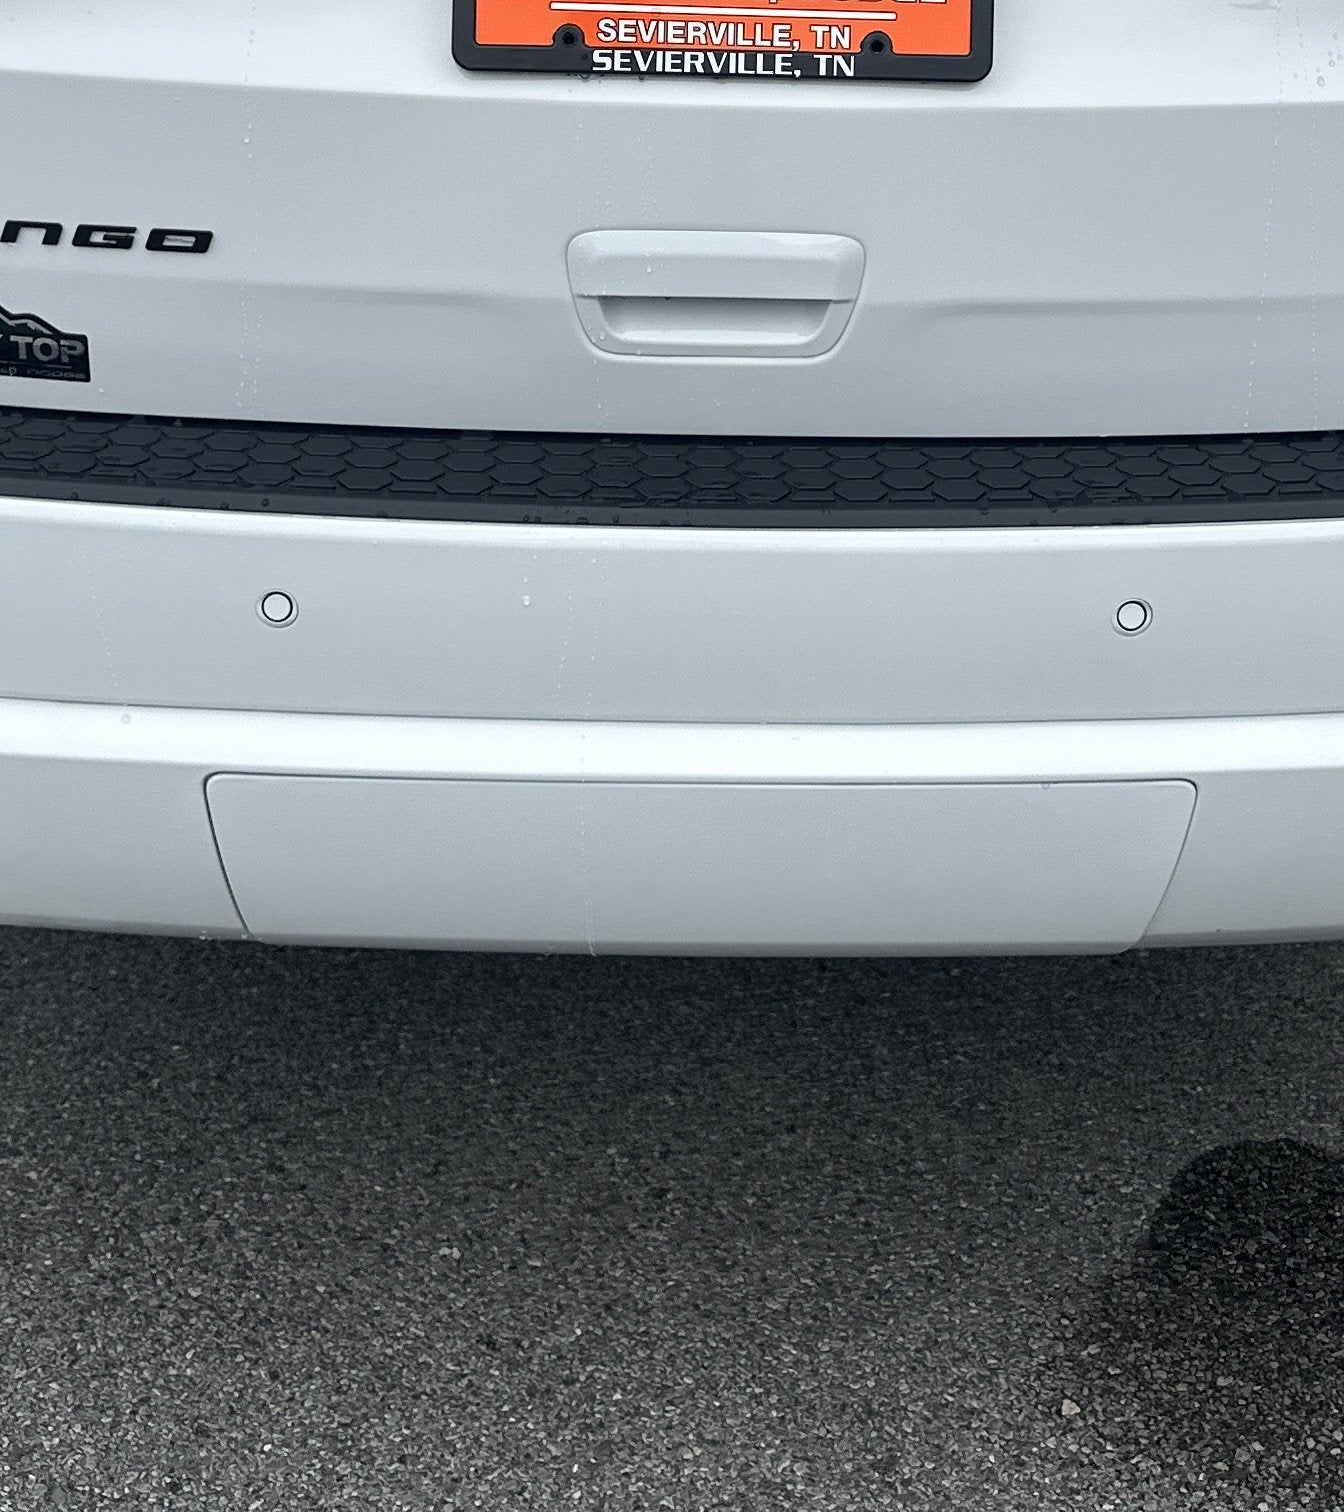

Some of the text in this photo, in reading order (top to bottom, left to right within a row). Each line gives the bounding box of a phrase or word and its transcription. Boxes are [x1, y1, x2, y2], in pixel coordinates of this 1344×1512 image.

[597, 19, 852, 51] SEVIERVILLE, TN
[592, 49, 855, 78] SEVIERVILLE, TN
[10, 336, 85, 363] TOP
